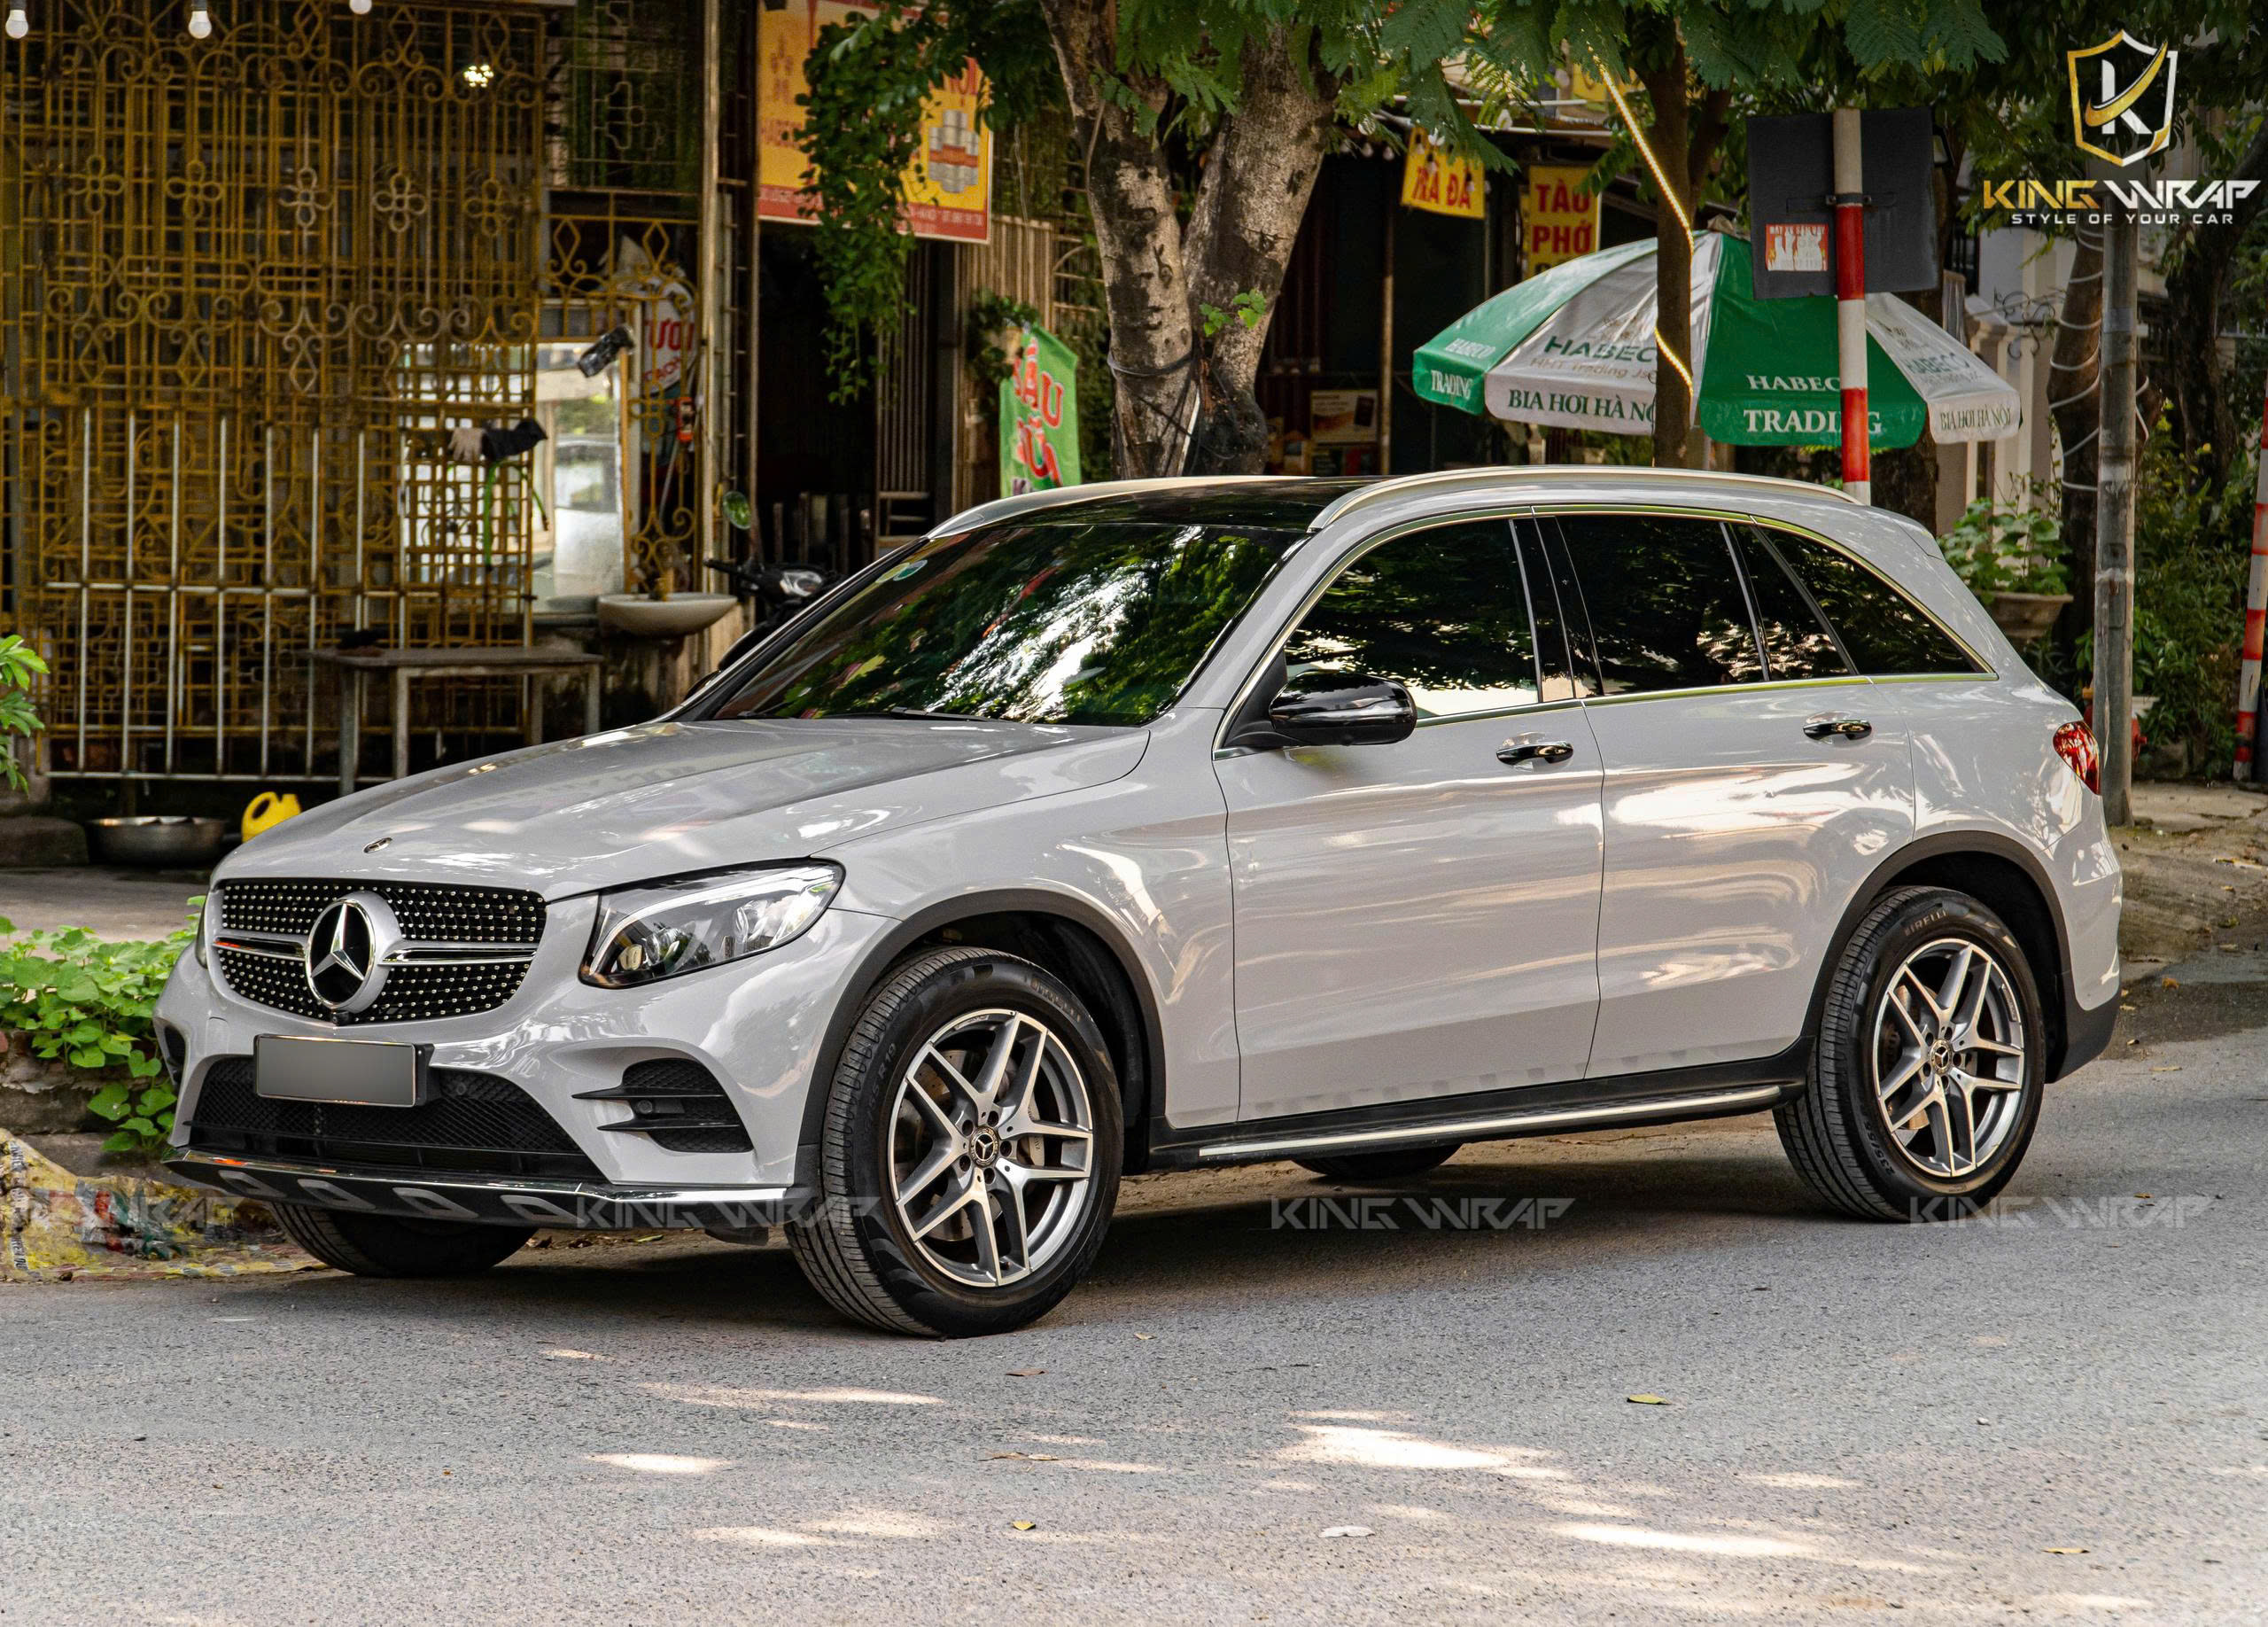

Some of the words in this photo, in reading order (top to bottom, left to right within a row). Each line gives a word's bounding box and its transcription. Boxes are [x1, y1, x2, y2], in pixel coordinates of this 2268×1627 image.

[1543, 335, 1658, 362] HABEC
[1431, 370, 1473, 401] TRADING
[1745, 374, 1840, 392] HABEC
[1508, 389, 1544, 410] BIA
[1594, 393, 1625, 420] HÀ
[1743, 409, 1884, 434] TRADIG
